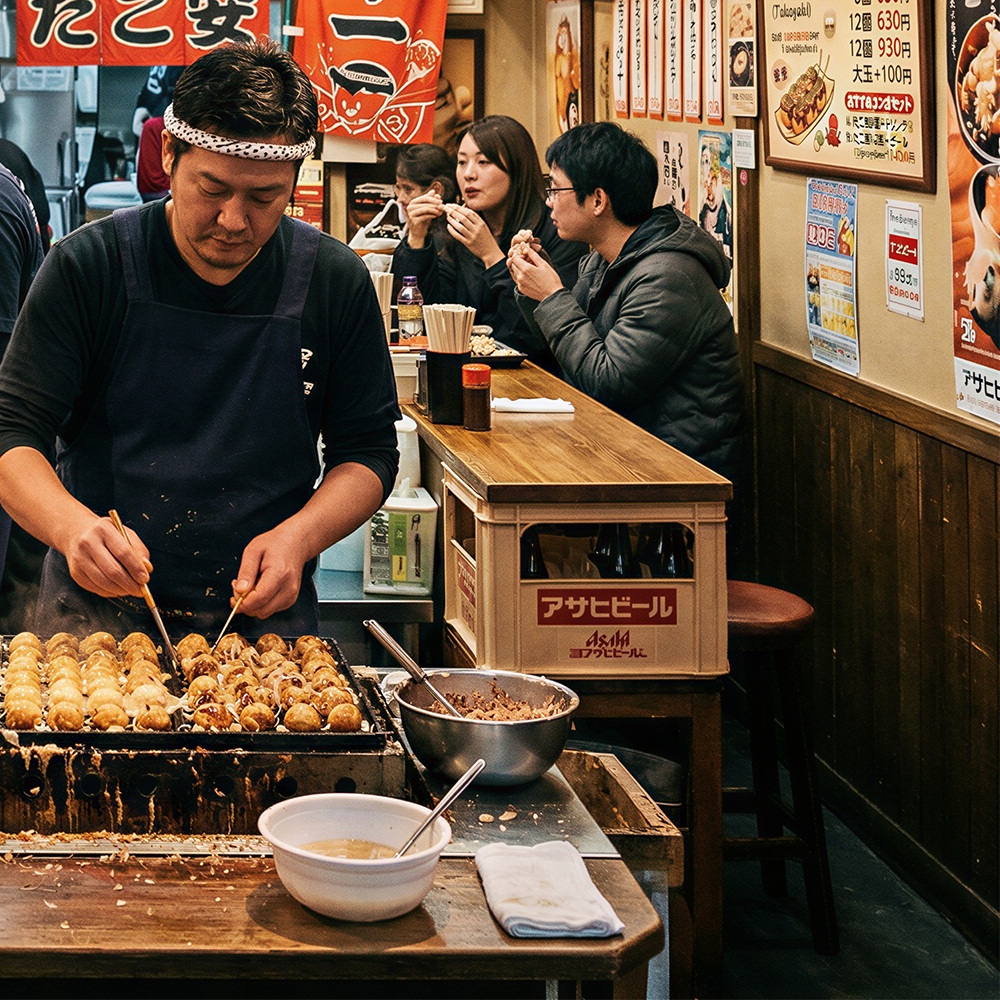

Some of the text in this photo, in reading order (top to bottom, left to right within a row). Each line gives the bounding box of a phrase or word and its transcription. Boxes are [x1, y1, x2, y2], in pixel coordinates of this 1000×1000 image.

[877, 9, 911, 32] 630円
[877, 36, 912, 59] 930円
[541, 596, 673, 618] アサヒビール
